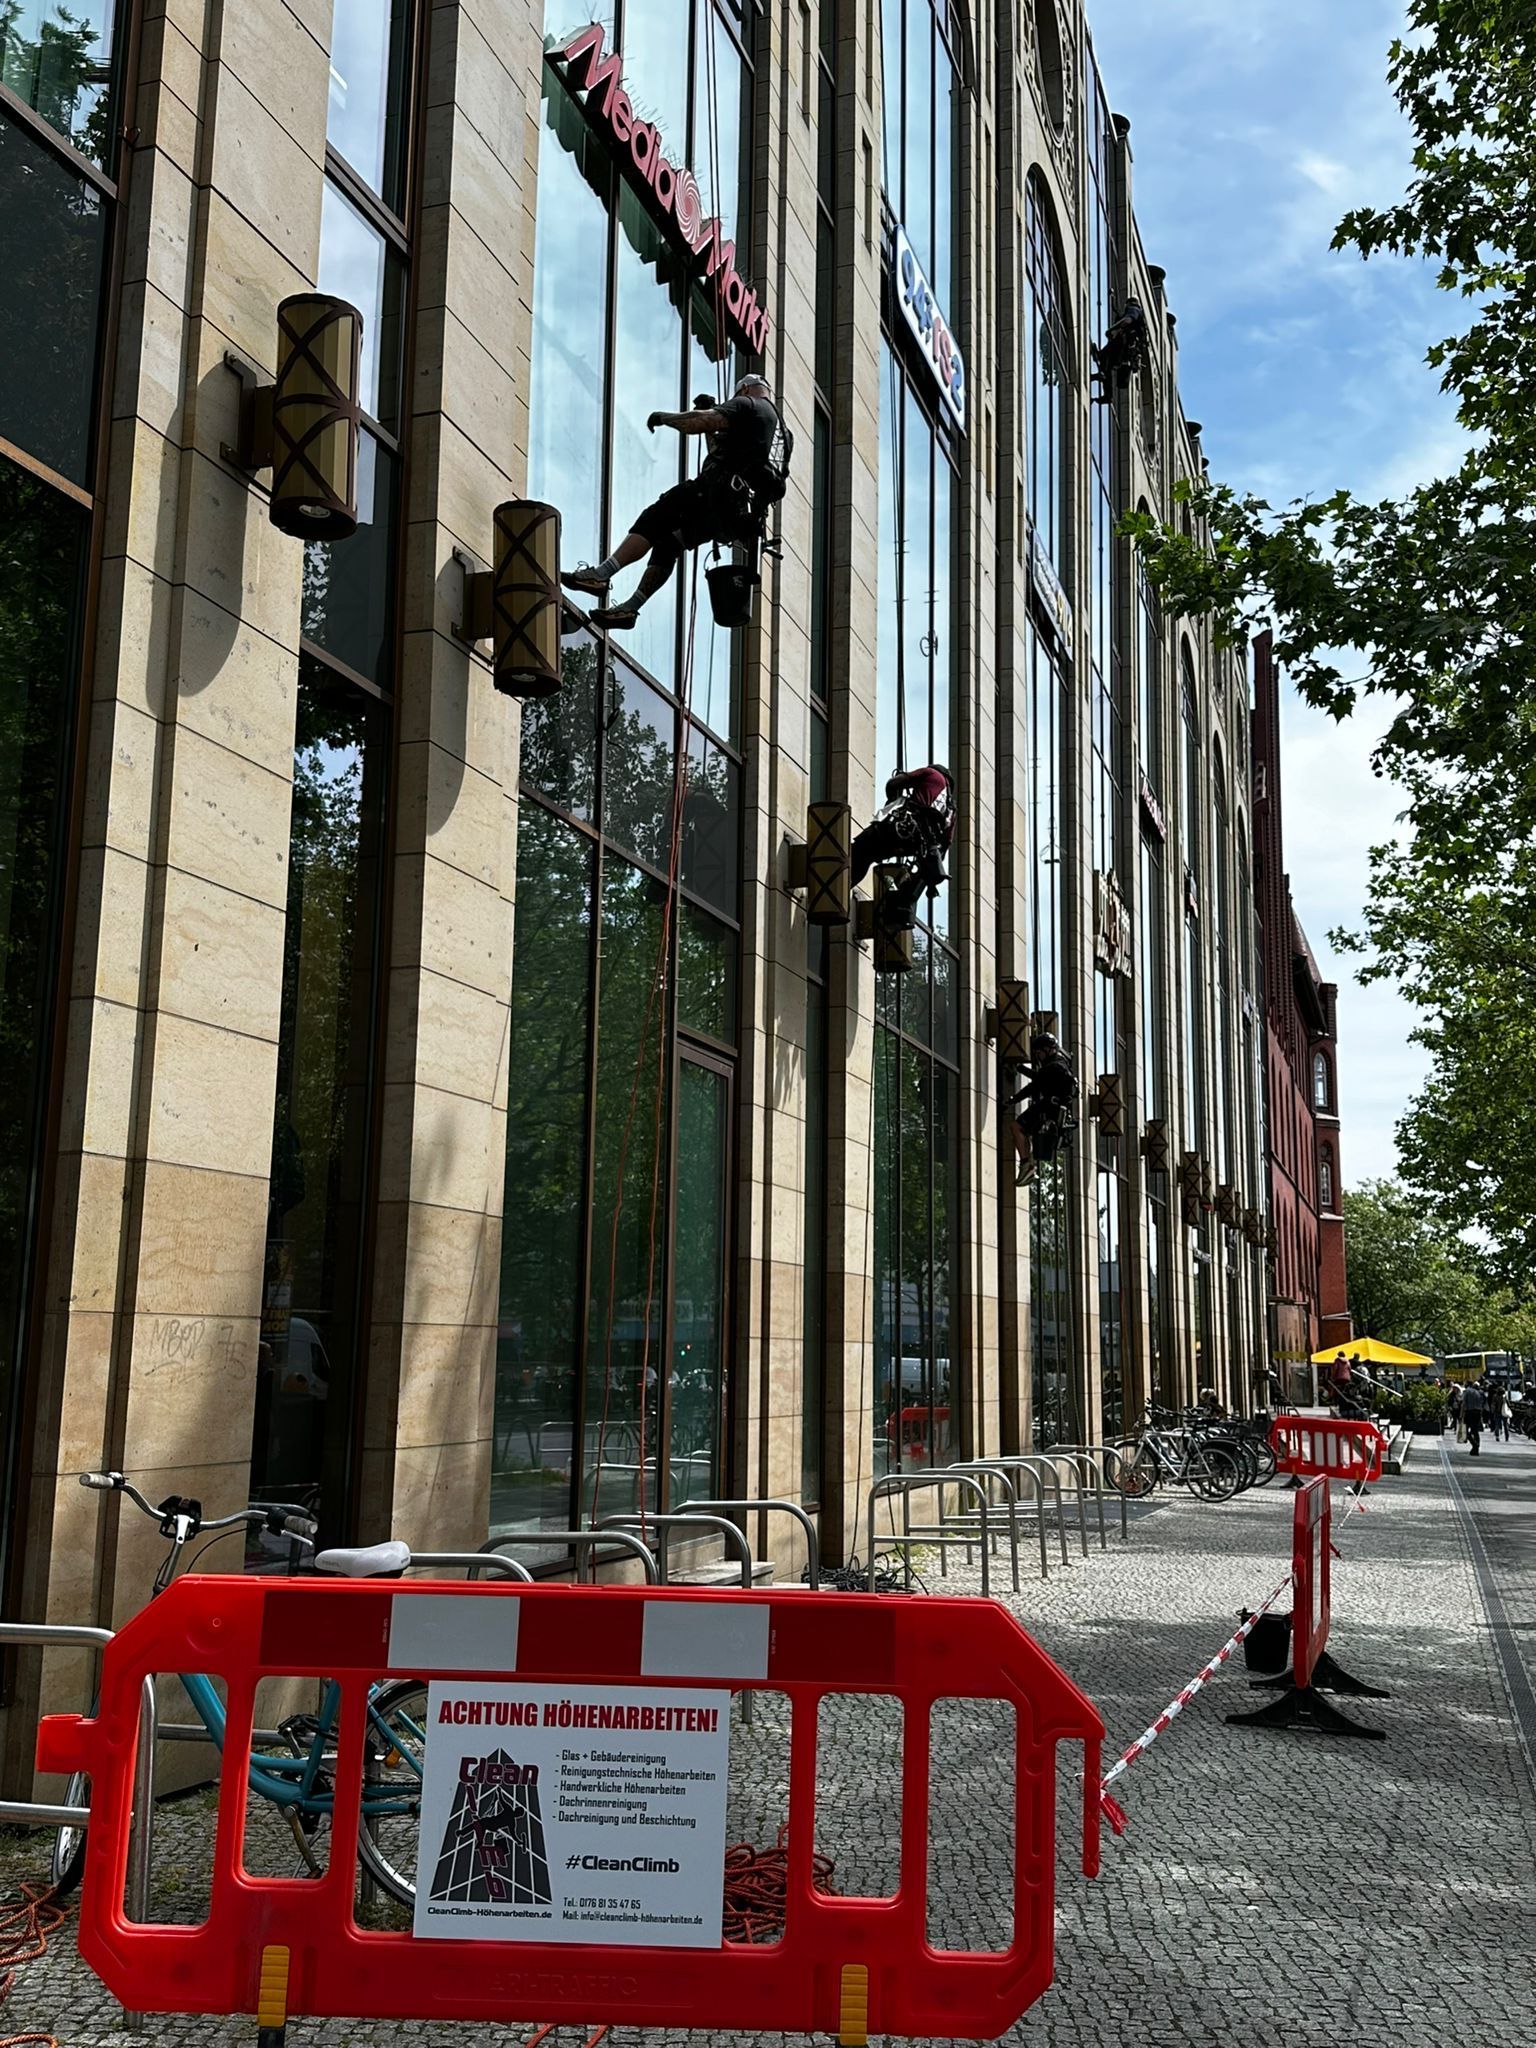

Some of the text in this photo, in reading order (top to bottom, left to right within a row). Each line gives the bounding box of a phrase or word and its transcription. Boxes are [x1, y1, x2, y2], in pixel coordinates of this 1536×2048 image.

[438, 1700, 718, 1732] ACHTUNG HÖHENARBEITEN!
[561, 1750, 580, 1761] Glas
[591, 1751, 666, 1766] Gebäudereinigung
[459, 1757, 539, 1786] Clean
[561, 1765, 716, 1781] Reinigungstechnische Höhenarbeiten
[560, 1780, 686, 1795] Handwerkliche Höhenarbeiten
[559, 1795, 647, 1811] Dachrinnenreinigung
[558, 1811, 696, 1828] Dachreinigung und Beschichtung
[565, 1854, 680, 1873] #CleanClimb
[579, 1898, 597, 1908] 0176
[598, 1898, 606, 1908] 81
[608, 1899, 618, 1908] 35
[619, 1899, 629, 1909] 47
[630, 1899, 641, 1909] 65
[427, 1907, 553, 1919] CleanClimb-Höhenarbeiten.de
[562, 1910, 579, 1921] Mail:
